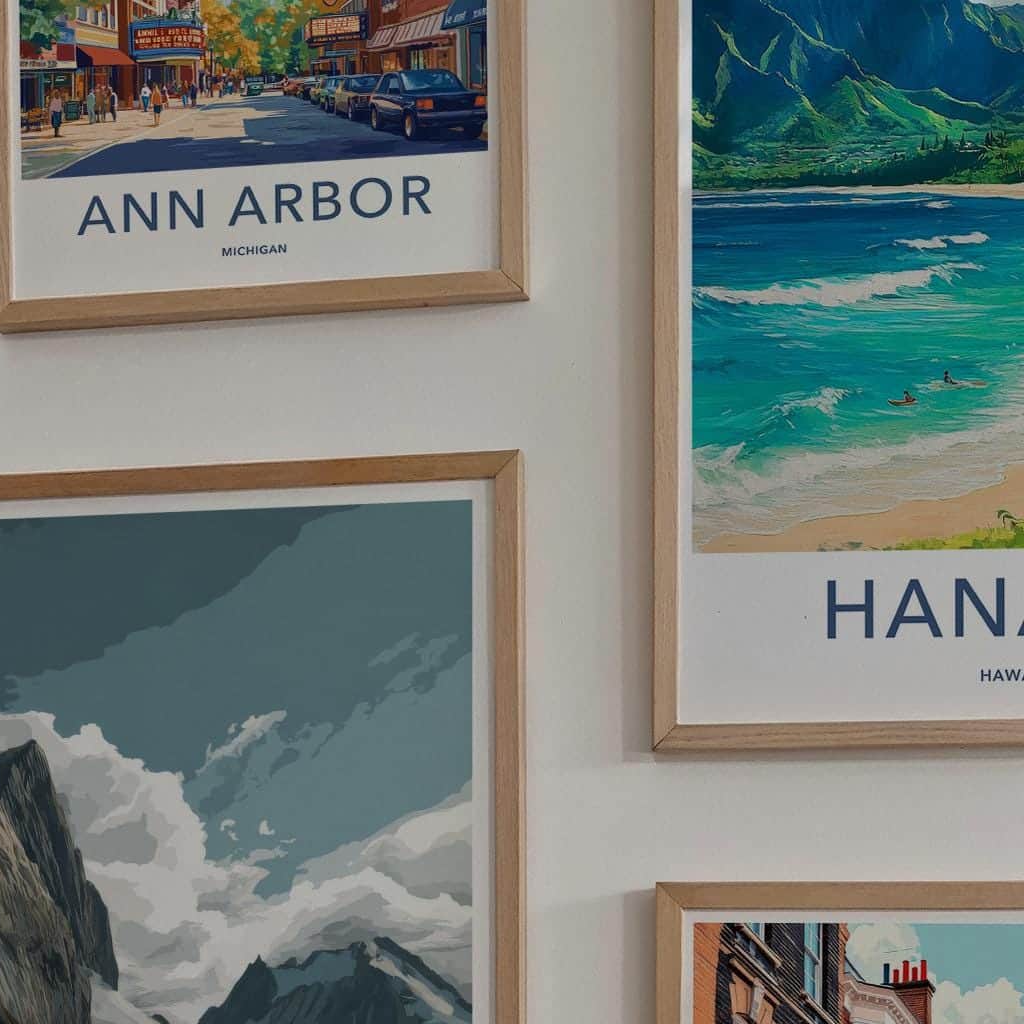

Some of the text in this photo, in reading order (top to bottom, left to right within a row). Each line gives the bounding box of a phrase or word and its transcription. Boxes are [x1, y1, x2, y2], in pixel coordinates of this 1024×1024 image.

[76, 175, 432, 236] ANN ARBOR
[221, 243, 288, 257] MICHIGAN
[826, 577, 1024, 640] HAN
[980, 668, 1024, 682] HAW
